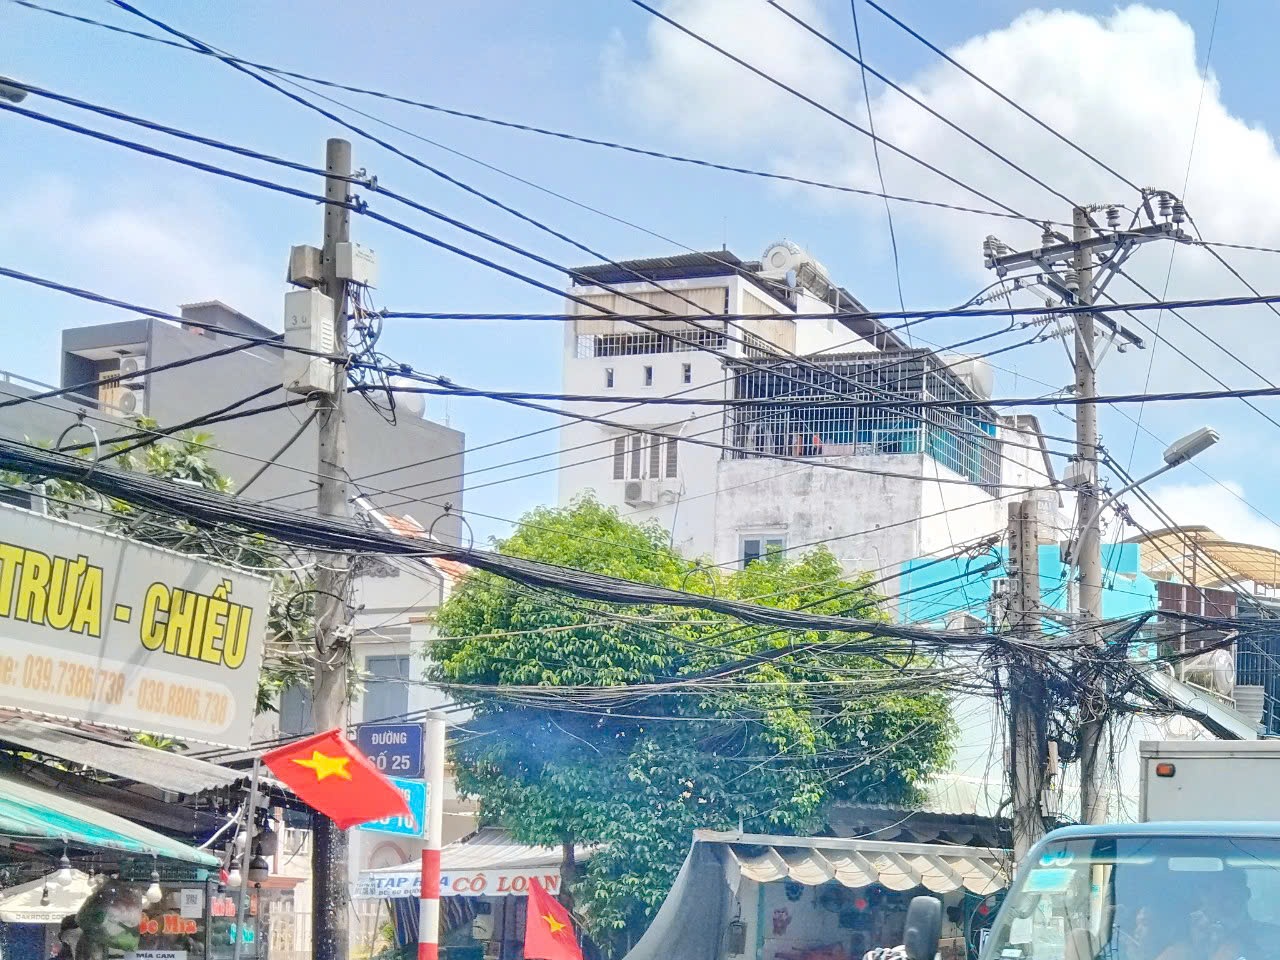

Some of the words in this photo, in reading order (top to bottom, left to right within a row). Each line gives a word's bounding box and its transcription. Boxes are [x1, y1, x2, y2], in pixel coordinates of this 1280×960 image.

[0, 541, 104, 639] TRƯA
[140, 578, 254, 670] CHIỀU
[371, 730, 408, 745] ĐƯỜNG
[391, 755, 411, 771] 25
[452, 872, 488, 893] CÔ
